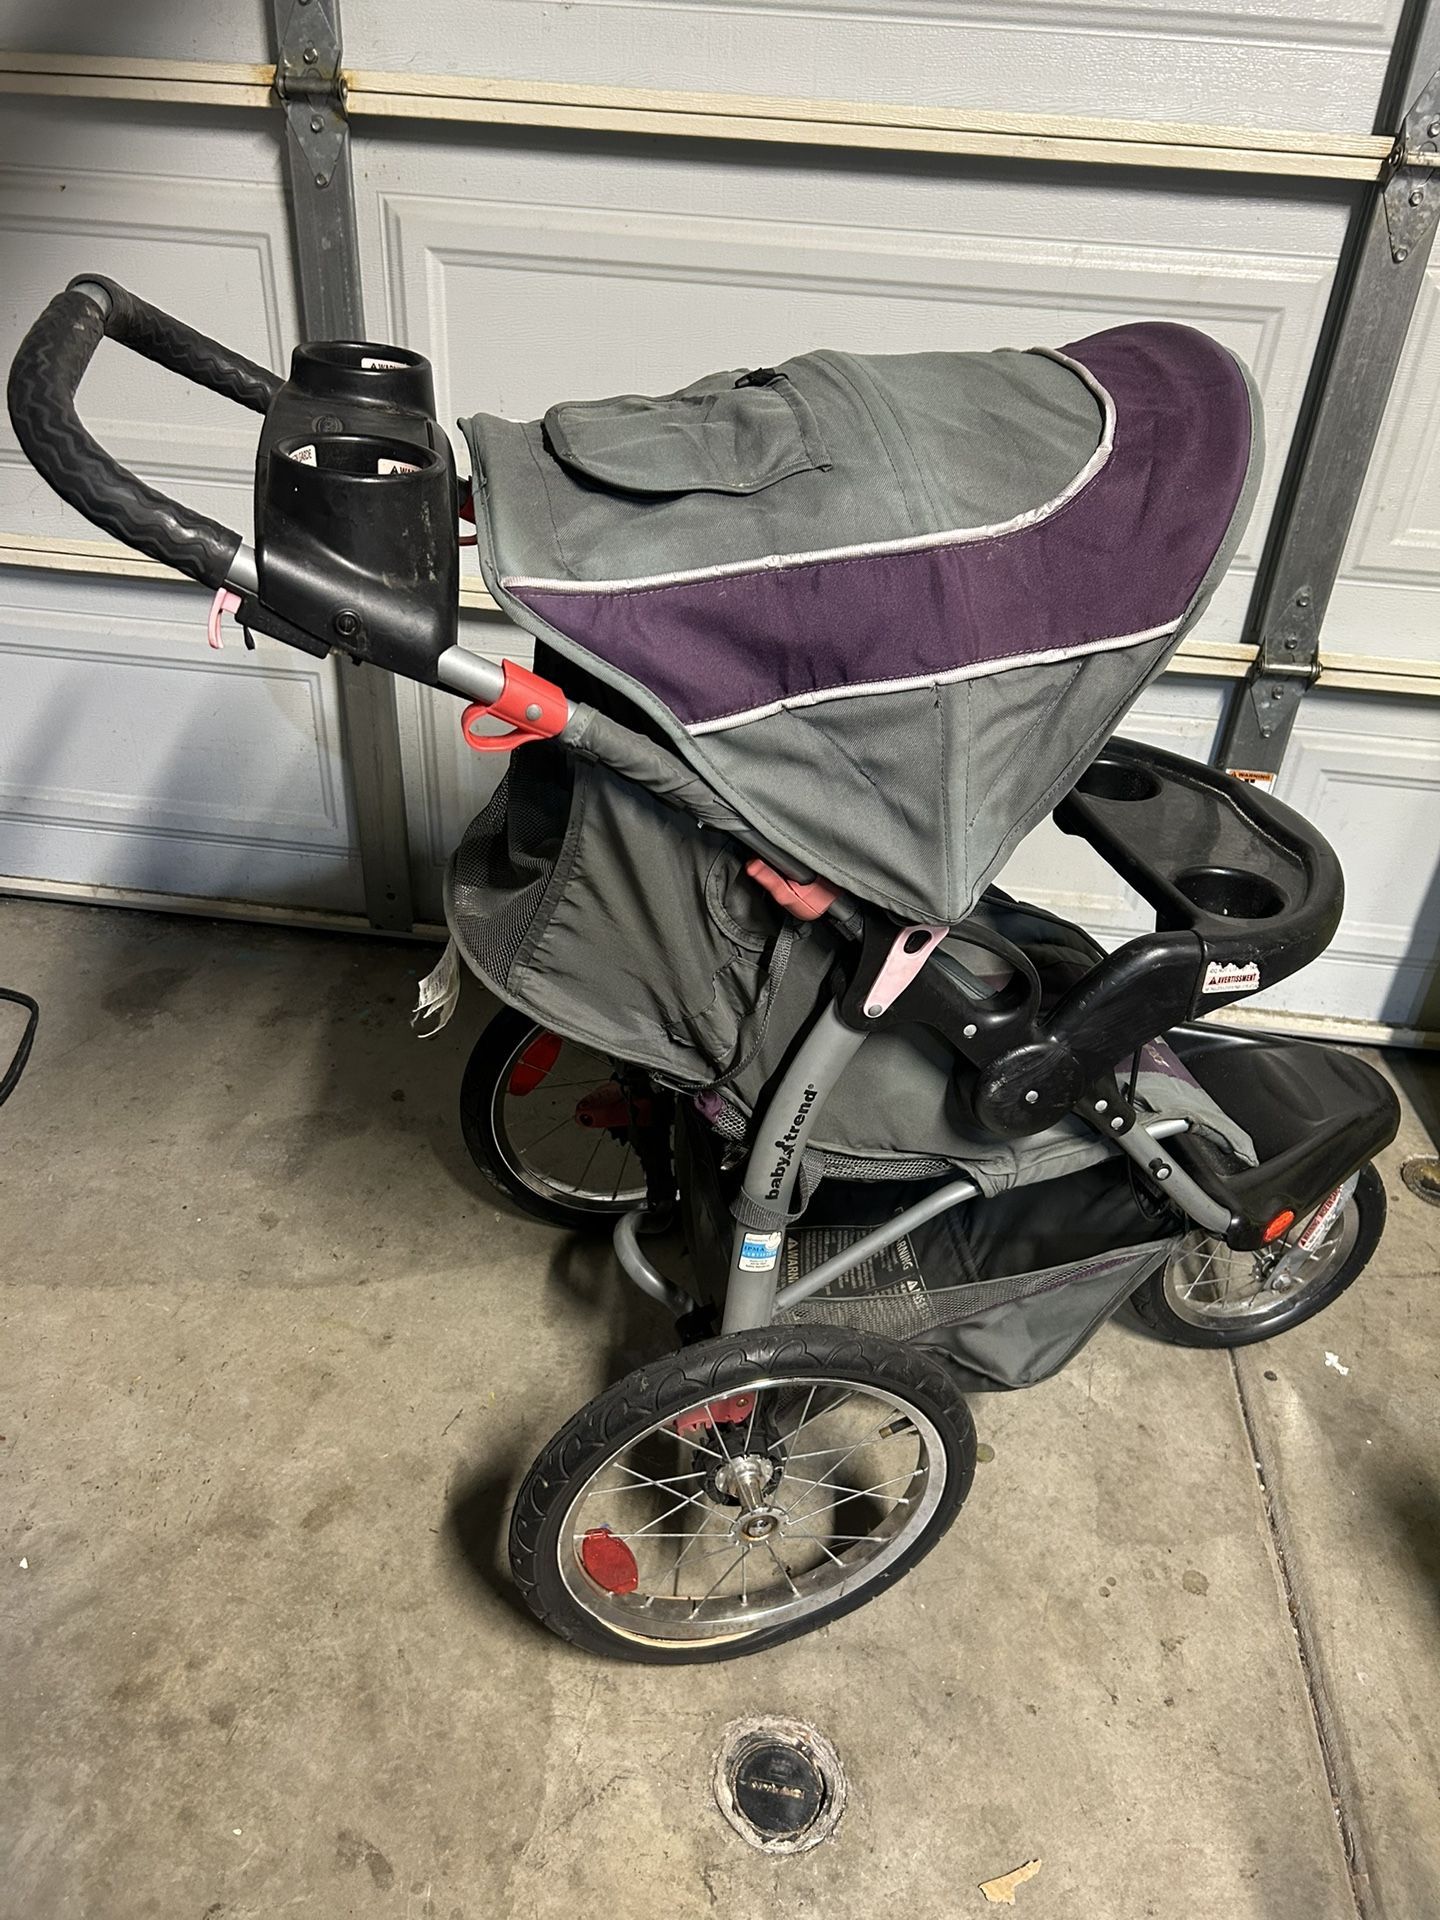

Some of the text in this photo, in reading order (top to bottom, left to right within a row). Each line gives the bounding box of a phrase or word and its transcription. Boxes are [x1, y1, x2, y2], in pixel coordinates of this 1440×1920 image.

[1238, 772, 1271, 780] WARNING
[765, 1089, 818, 1200] baby trend
